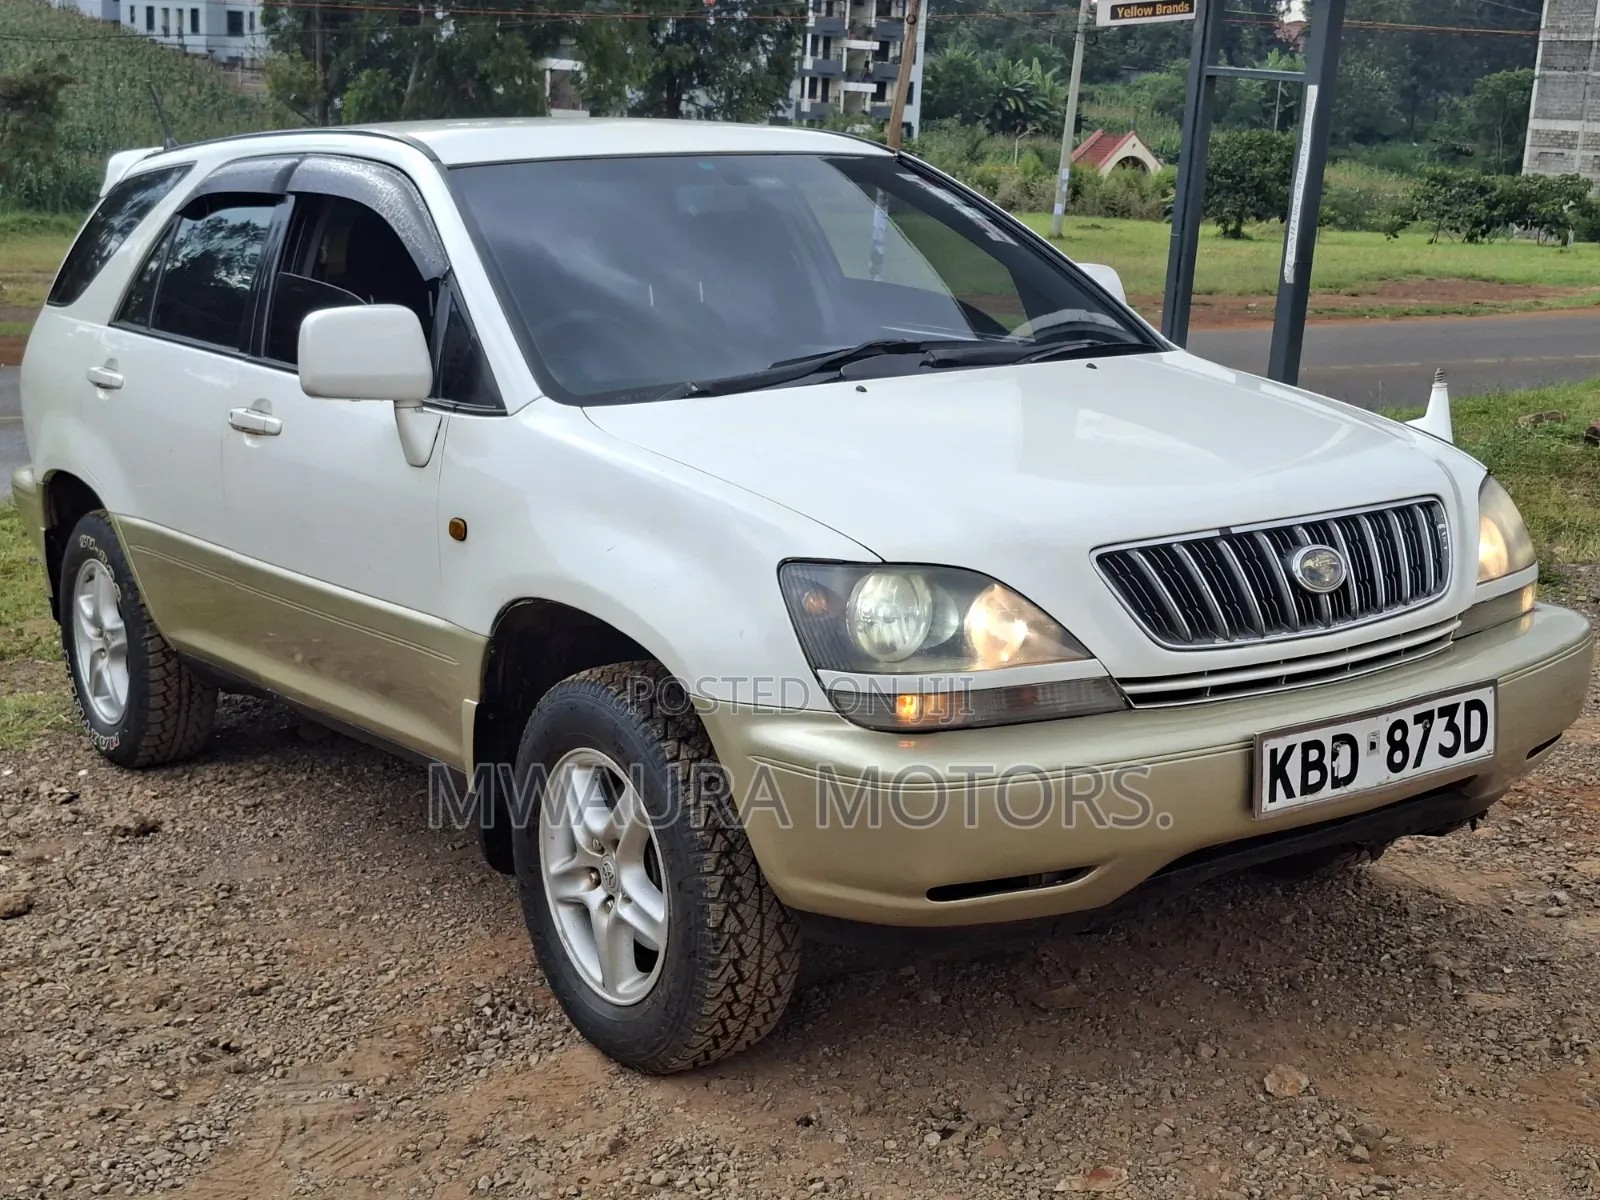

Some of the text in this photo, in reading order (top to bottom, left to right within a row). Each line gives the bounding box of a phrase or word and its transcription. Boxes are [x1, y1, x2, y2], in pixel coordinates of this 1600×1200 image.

[1117, 2, 1190, 18] Yellow Brands
[1267, 698, 1489, 804] KBD 873D
